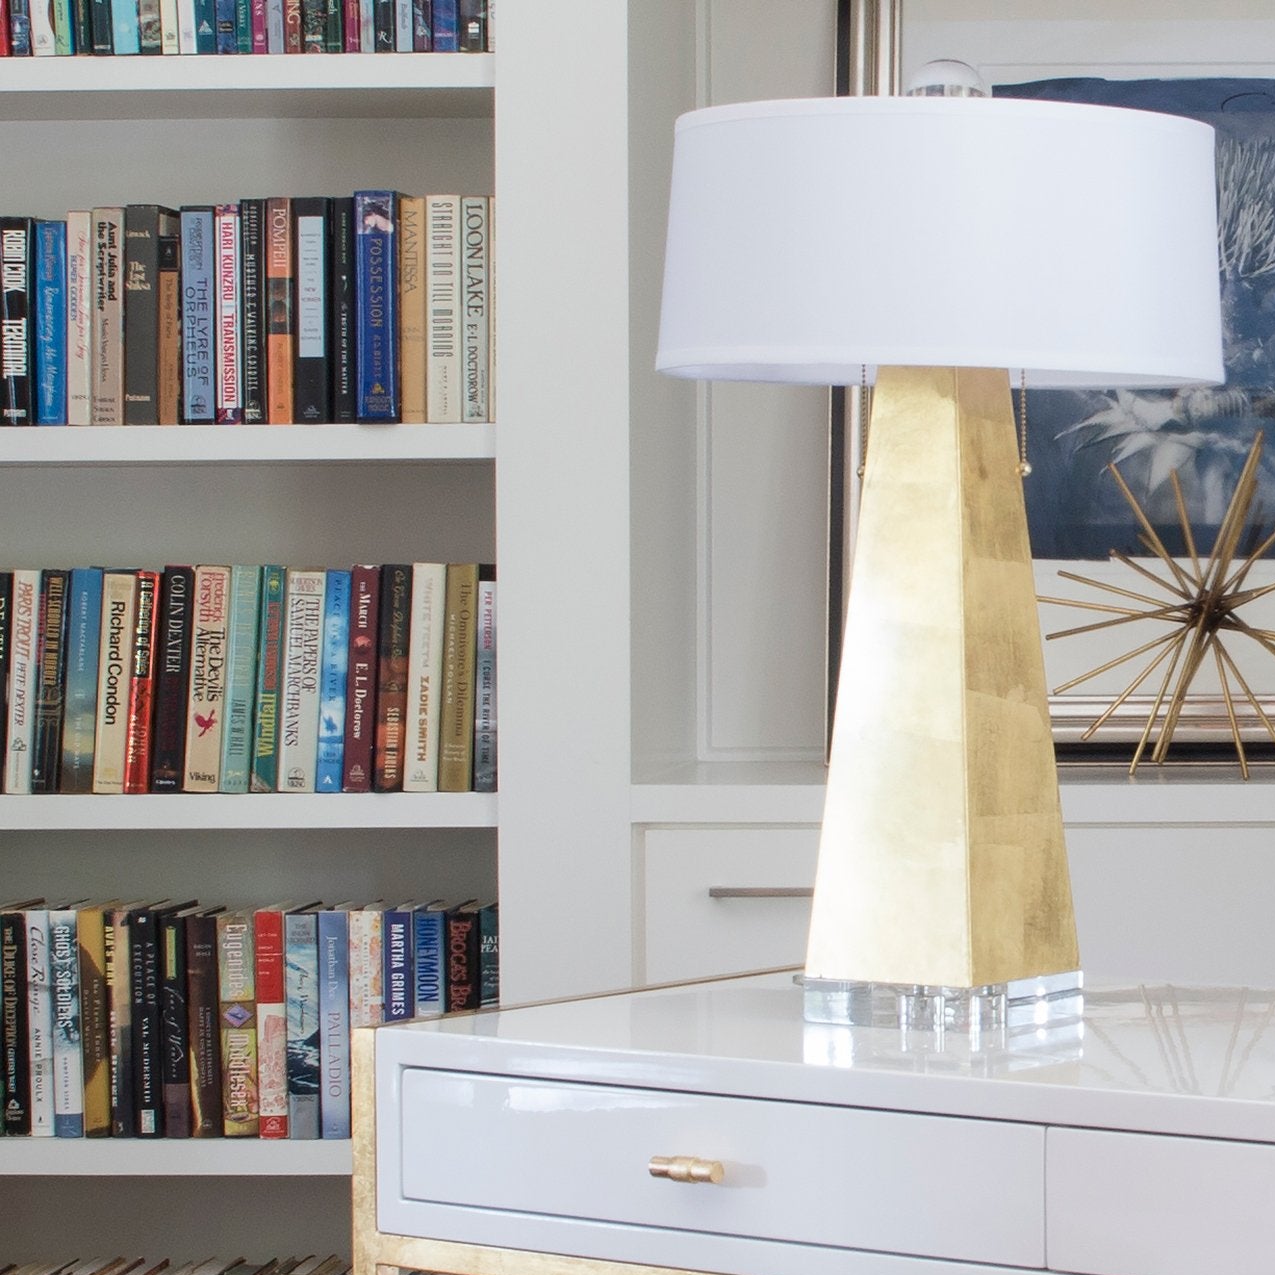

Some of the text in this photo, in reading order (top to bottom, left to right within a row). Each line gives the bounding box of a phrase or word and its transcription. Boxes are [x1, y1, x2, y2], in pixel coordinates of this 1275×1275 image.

[96, 222, 107, 312] the Scriptwriter
[107, 222, 118, 301] Aunt Julia and
[273, 208, 287, 268] POMPEII
[403, 210, 419, 295] MANTISSA
[431, 202, 454, 357] STRAIGHT ON TILL MORNING
[466, 204, 484, 317] LOON LAKE
[2, 230, 26, 379] ROBIN COOK TERMINAL
[222, 222, 235, 402] HARI KUNZRU TRANSMISSION
[369, 238, 384, 328] POSSESSION
[185, 286, 197, 378] ORPHEUS
[197, 277, 209, 386] THE LYRE OF
[169, 574, 186, 615] COLIN
[199, 572, 213, 622] Forsyth
[213, 573, 225, 623] Frederick
[105, 601, 125, 725] Richard Condon
[166, 620, 183, 672] DEXTER
[192, 626, 209, 702] Alternative
[206, 627, 225, 702] The Devil's
[284, 598, 304, 746] SAMUEL MARCHBANKS
[301, 599, 320, 693] THE PAPERS OF
[446, 614, 456, 704] MICHAEL POLLAN
[454, 582, 471, 737] The Omnivore's Dilemma
[256, 693, 277, 757] Windfall
[417, 675, 430, 762] ZADIE SMITH
[189, 771, 216, 784] Viking
[54, 926, 72, 1028] GHOST SOLDIERS
[222, 924, 248, 998] Eugenides
[325, 936, 338, 978] Jonathan
[391, 924, 405, 1015] MARTHA GRIMES
[416, 919, 440, 1001] HONEYMOON
[29, 926, 45, 1103] Close Range ANNIE PROULX
[327, 1012, 342, 1097] PALLADIO
[226, 1034, 250, 1108] Middlesex
